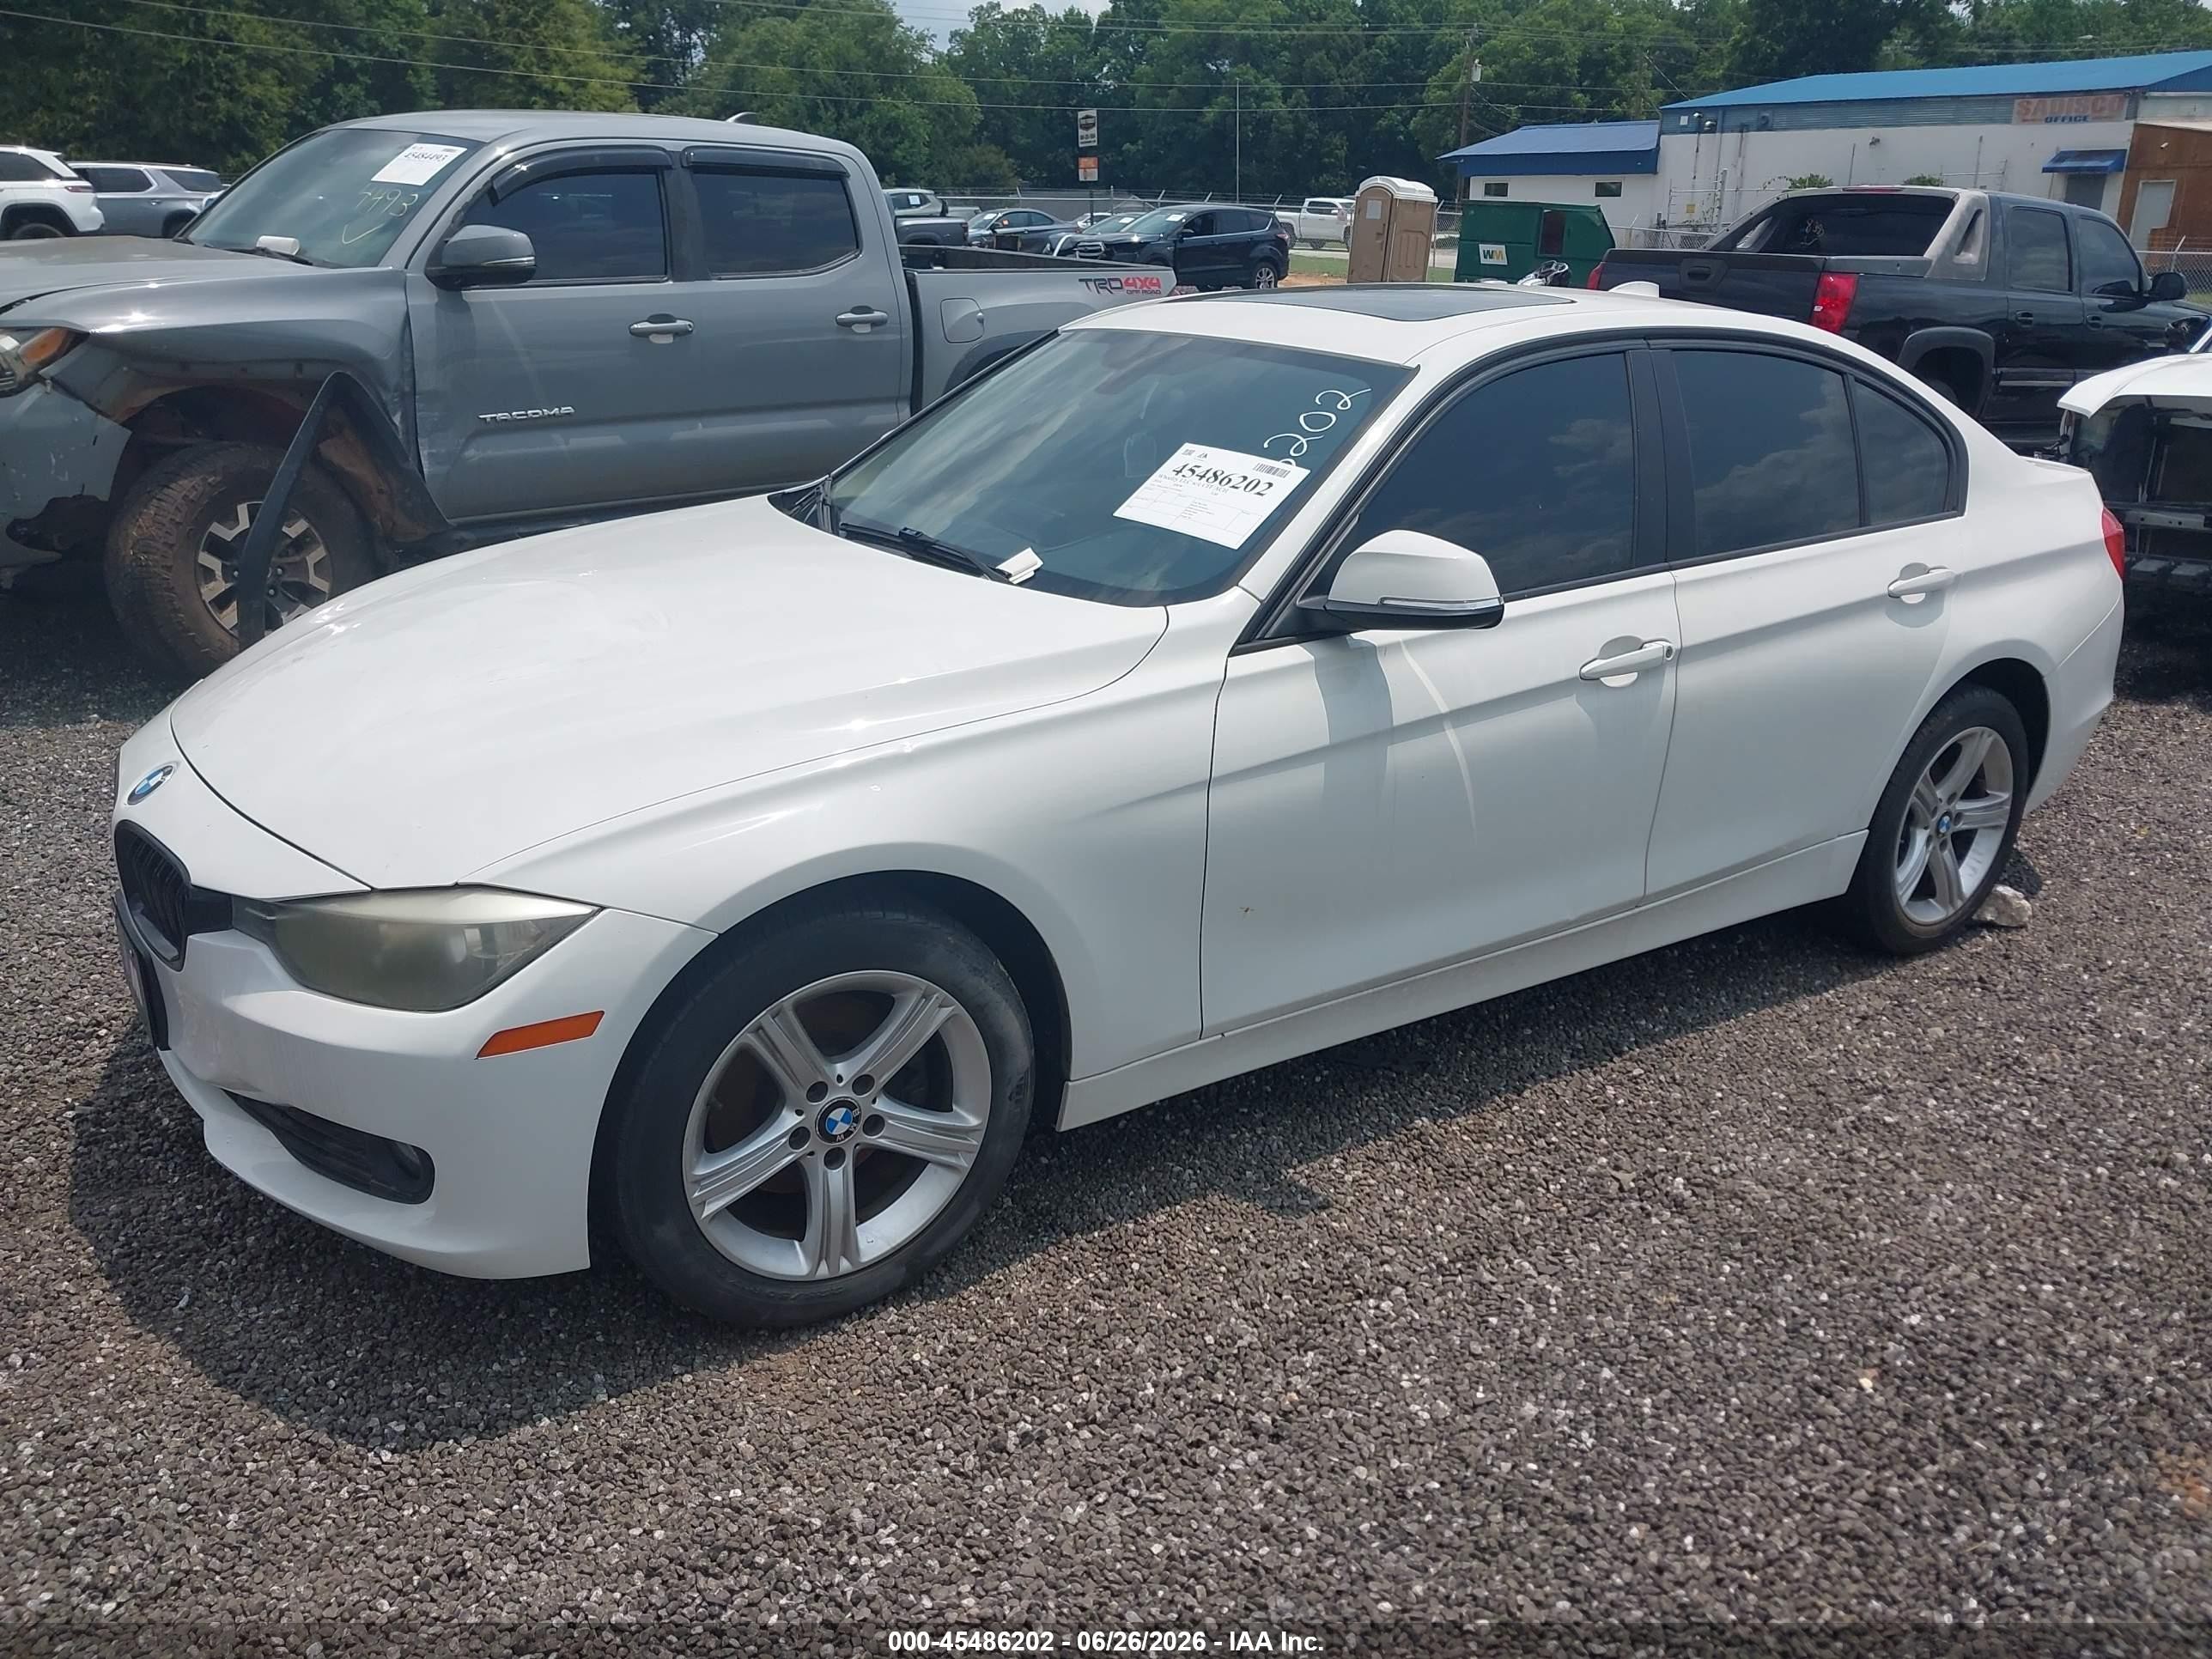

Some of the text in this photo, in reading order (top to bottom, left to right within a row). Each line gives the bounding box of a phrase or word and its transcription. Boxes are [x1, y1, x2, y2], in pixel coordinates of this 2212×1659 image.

[2045, 115, 2089, 124] OFFICE
[1482, 249, 1504, 260] WM
[478, 406, 574, 422] TACOMA
[1171, 463, 1273, 497] 45486202
